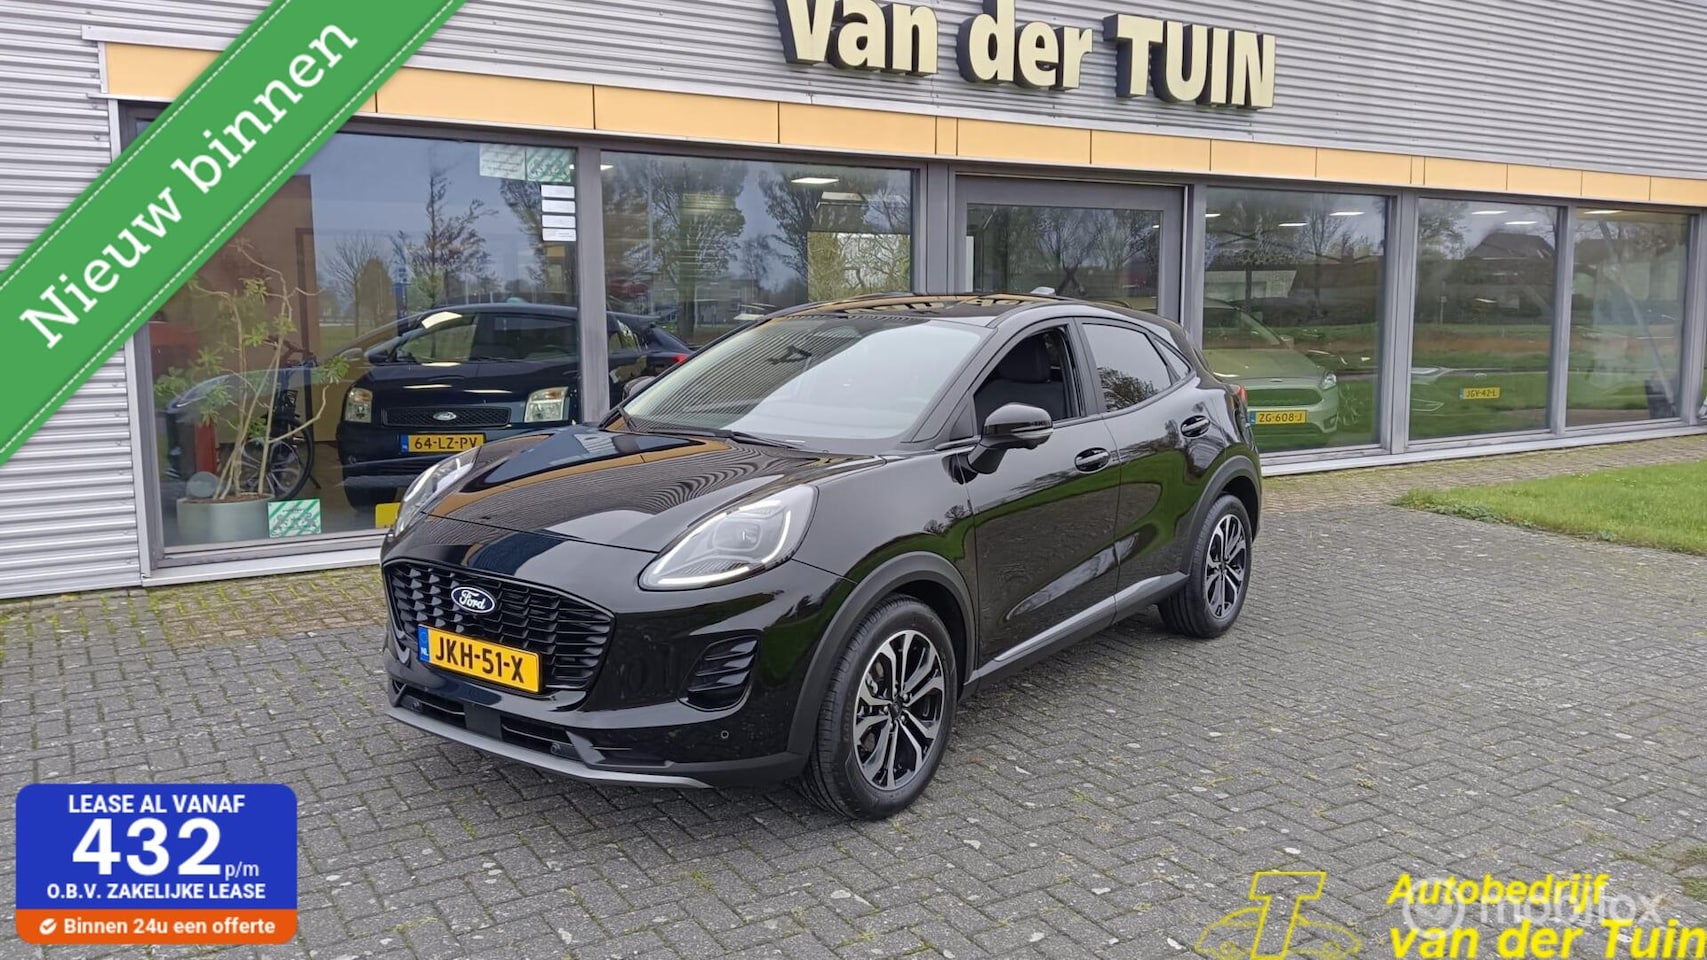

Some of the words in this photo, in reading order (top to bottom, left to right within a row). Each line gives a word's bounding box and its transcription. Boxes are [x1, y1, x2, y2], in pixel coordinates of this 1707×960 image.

[781, 0, 938, 75] Van
[963, 0, 1092, 88] der
[1109, 14, 1276, 109] TUIN
[1258, 412, 1303, 423] ZG-608-J
[414, 437, 478, 450] 64-LZ-PV
[458, 589, 487, 611] Ford
[435, 636, 525, 684] JKH-51-X
